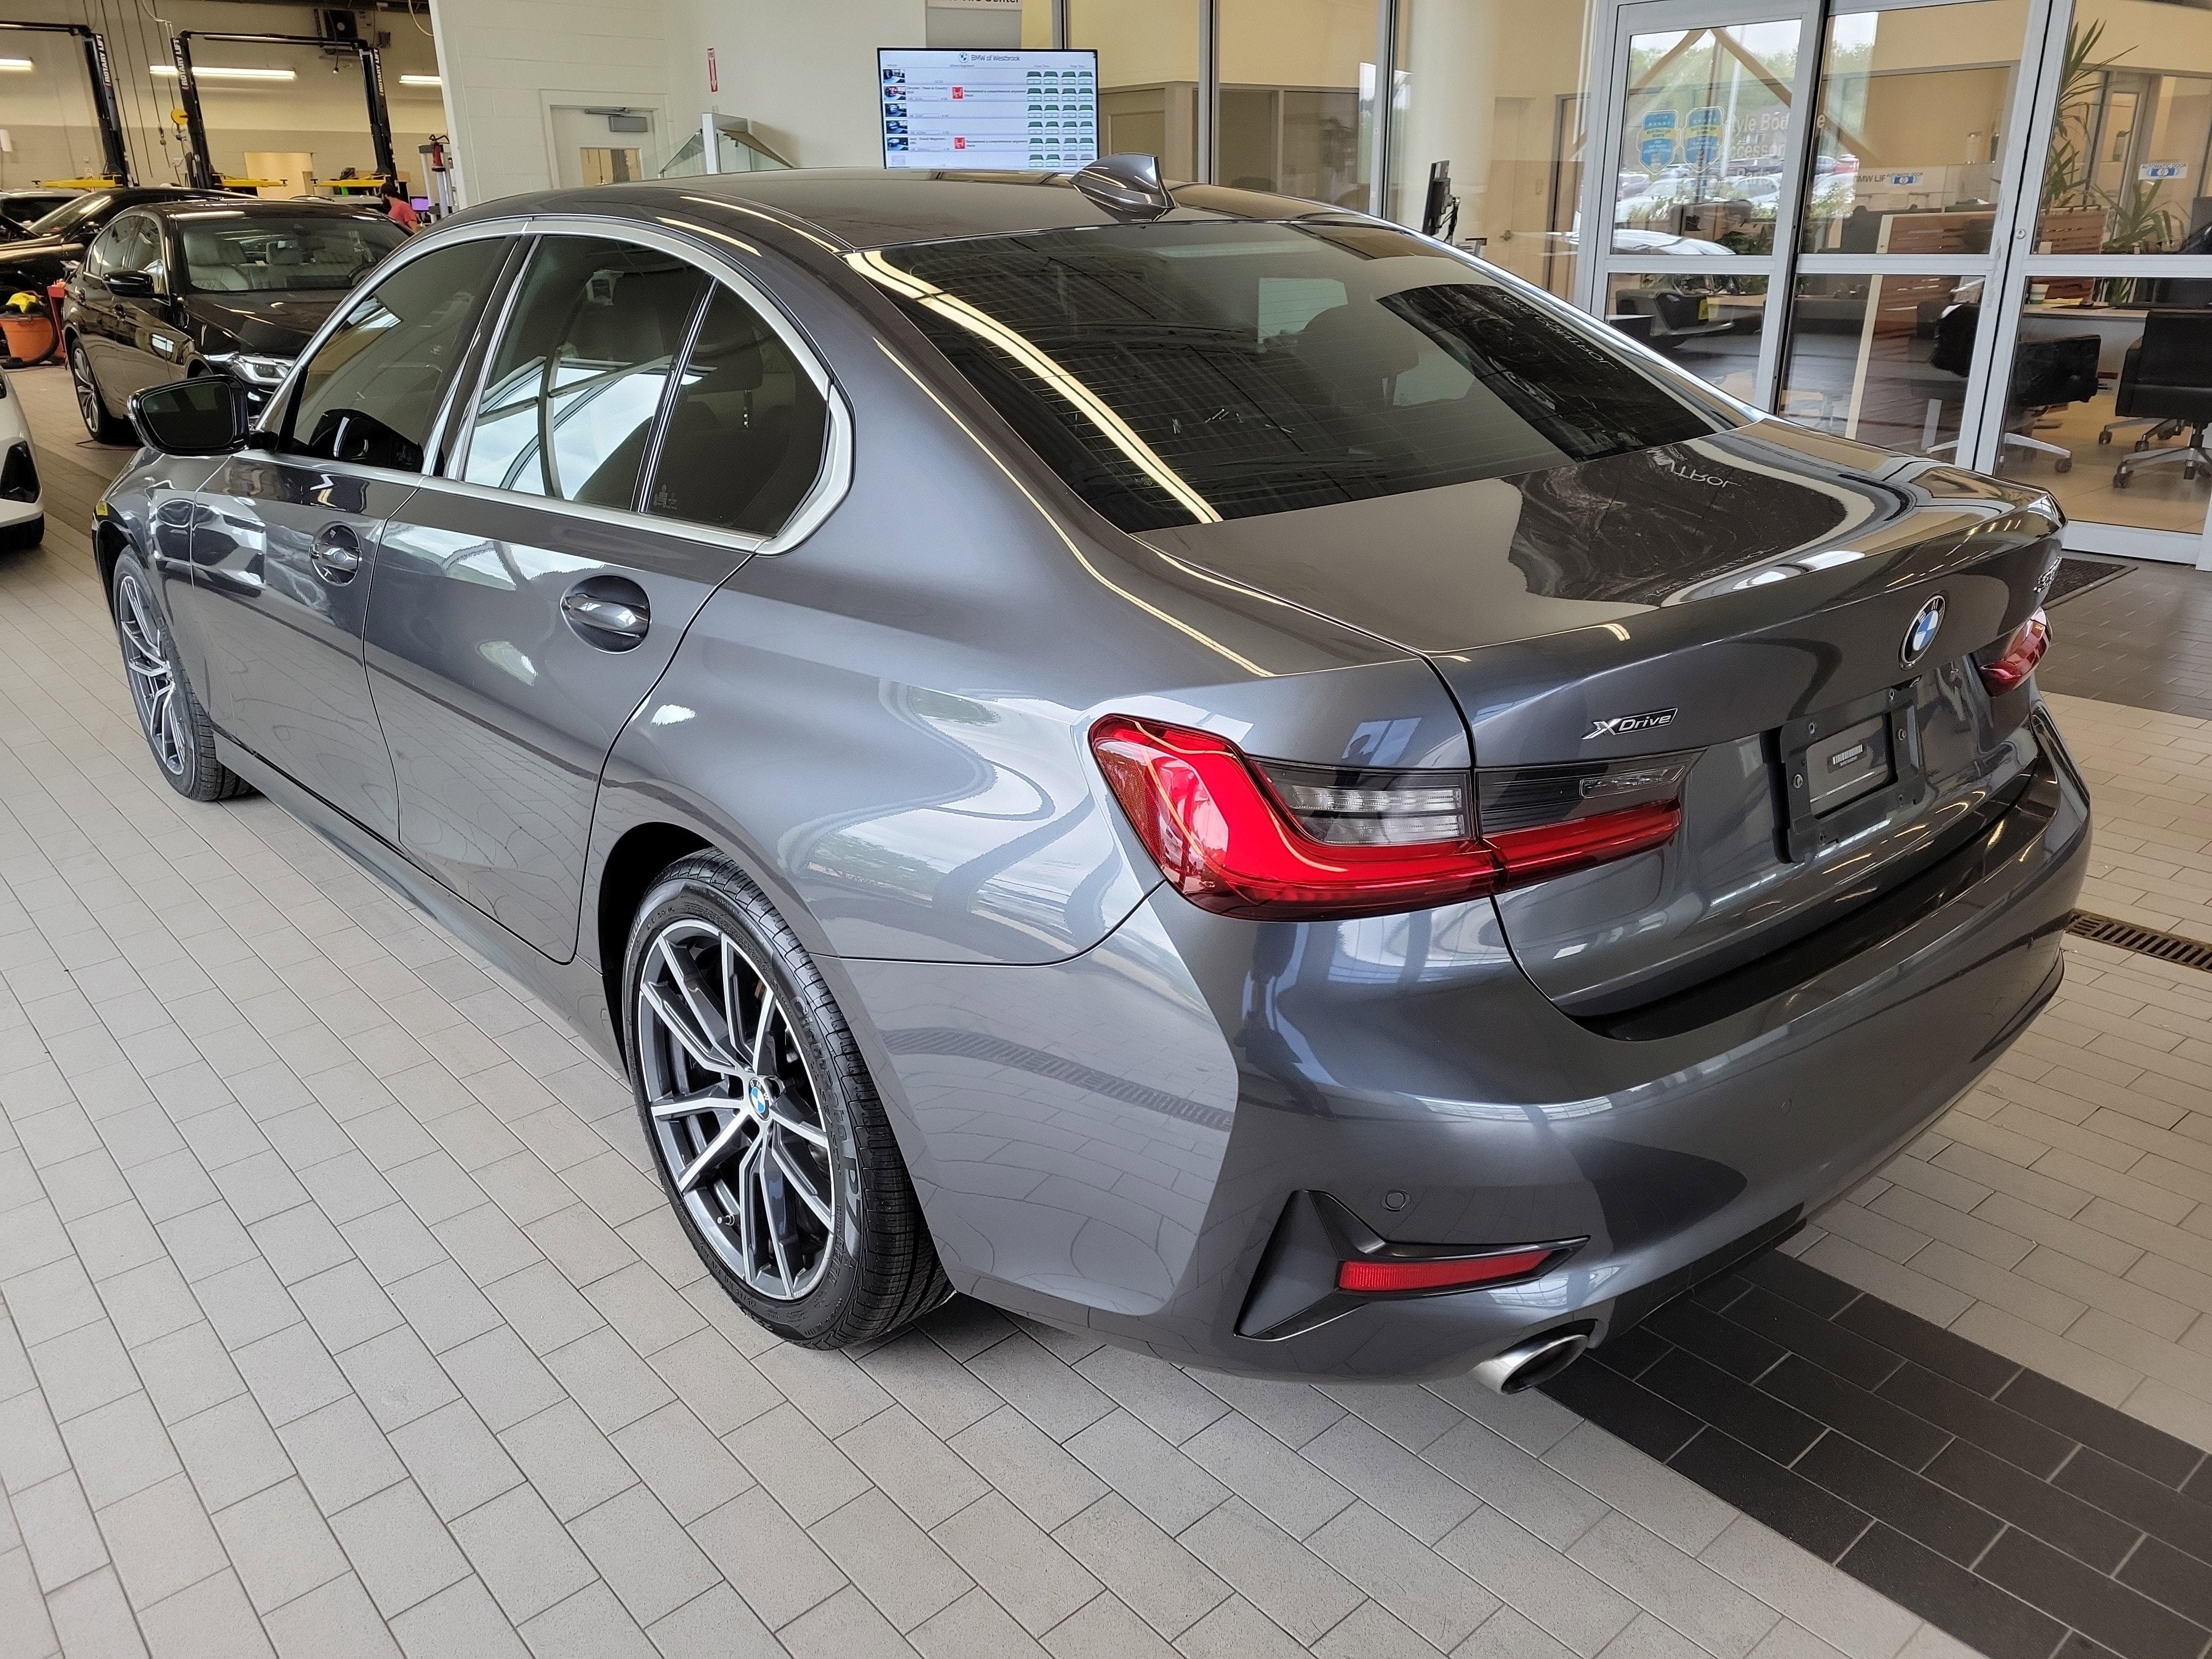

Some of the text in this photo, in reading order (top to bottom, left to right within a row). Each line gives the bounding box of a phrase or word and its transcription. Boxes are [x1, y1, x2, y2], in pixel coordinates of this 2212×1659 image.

[96, 34, 110, 82] ROTARY LIFT
[173, 38, 188, 86] ROTARY LIFT
[376, 64, 384, 93] ROTARY
